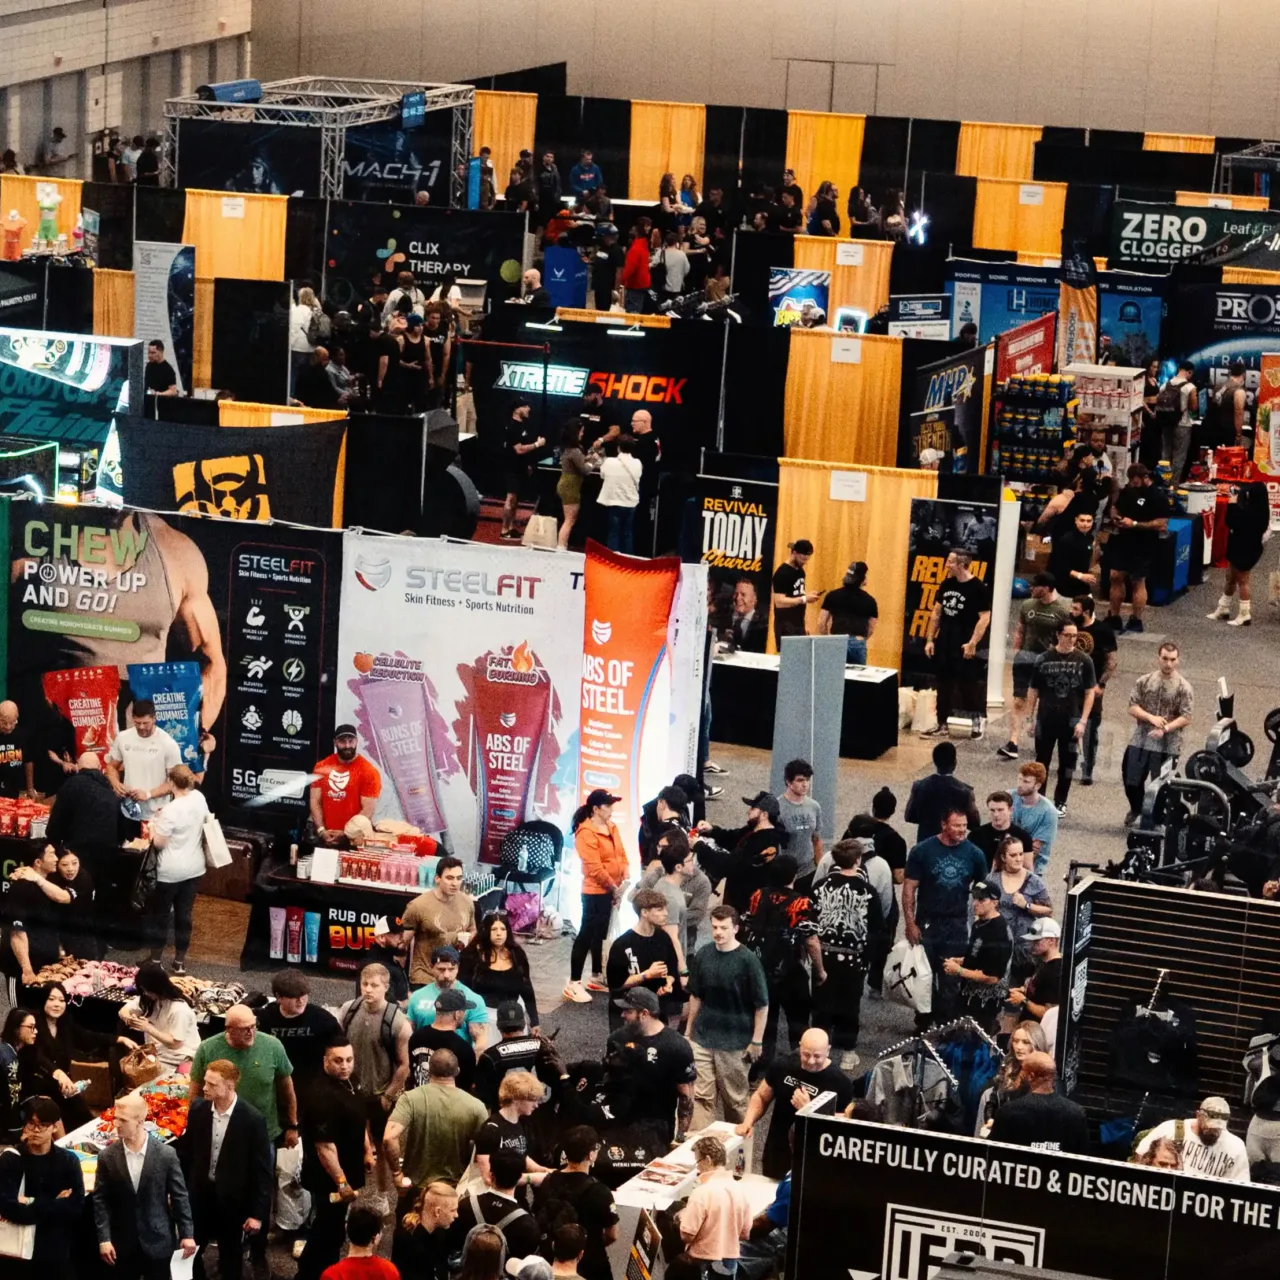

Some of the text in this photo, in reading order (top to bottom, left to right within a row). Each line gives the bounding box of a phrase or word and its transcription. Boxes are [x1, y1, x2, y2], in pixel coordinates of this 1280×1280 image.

[341, 160, 441, 187] MACH-1
[1121, 212, 1207, 243] ZERO
[1223, 222, 1251, 235] Leaf
[409, 241, 439, 256] CLIX
[409, 260, 471, 276] THERAPY
[589, 371, 688, 404] SHOCK
[704, 497, 767, 517] REVIVAL
[24, 520, 148, 565] CHEW
[702, 510, 768, 559] TODAY
[239, 554, 315, 575] STEELFIT
[701, 549, 763, 572] Church
[116, 571, 146, 593] UP
[238, 569, 312, 584] Skin Fitness Sports Nutrition
[405, 565, 542, 600] STEELFIT
[22, 584, 118, 613] AND GO!
[404, 592, 424, 605] Skin
[425, 594, 456, 608] Fitness
[465, 598, 493, 613] Sports
[495, 600, 534, 615] Nutrition
[582, 653, 634, 687] ABS OF
[69, 698, 102, 709] CREATINE
[152, 692, 185, 703] CREATINE
[72, 715, 107, 727] GUMMIES
[156, 709, 188, 721] GUMMIES
[380, 720, 423, 742] BUNS OF
[391, 738, 422, 756] STEEL
[486, 734, 531, 753] ABS OF
[232, 768, 257, 787] 5G
[232, 785, 257, 793] CREATINE
[329, 908, 380, 925] RUB ON
[329, 925, 377, 950] BUR
[270, 1027, 315, 1037] STEEL
[819, 1133, 1271, 1230] CAREFULLY CURATED & DESIGNED FOR THE
[941, 1225, 987, 1240] EST. 2004
